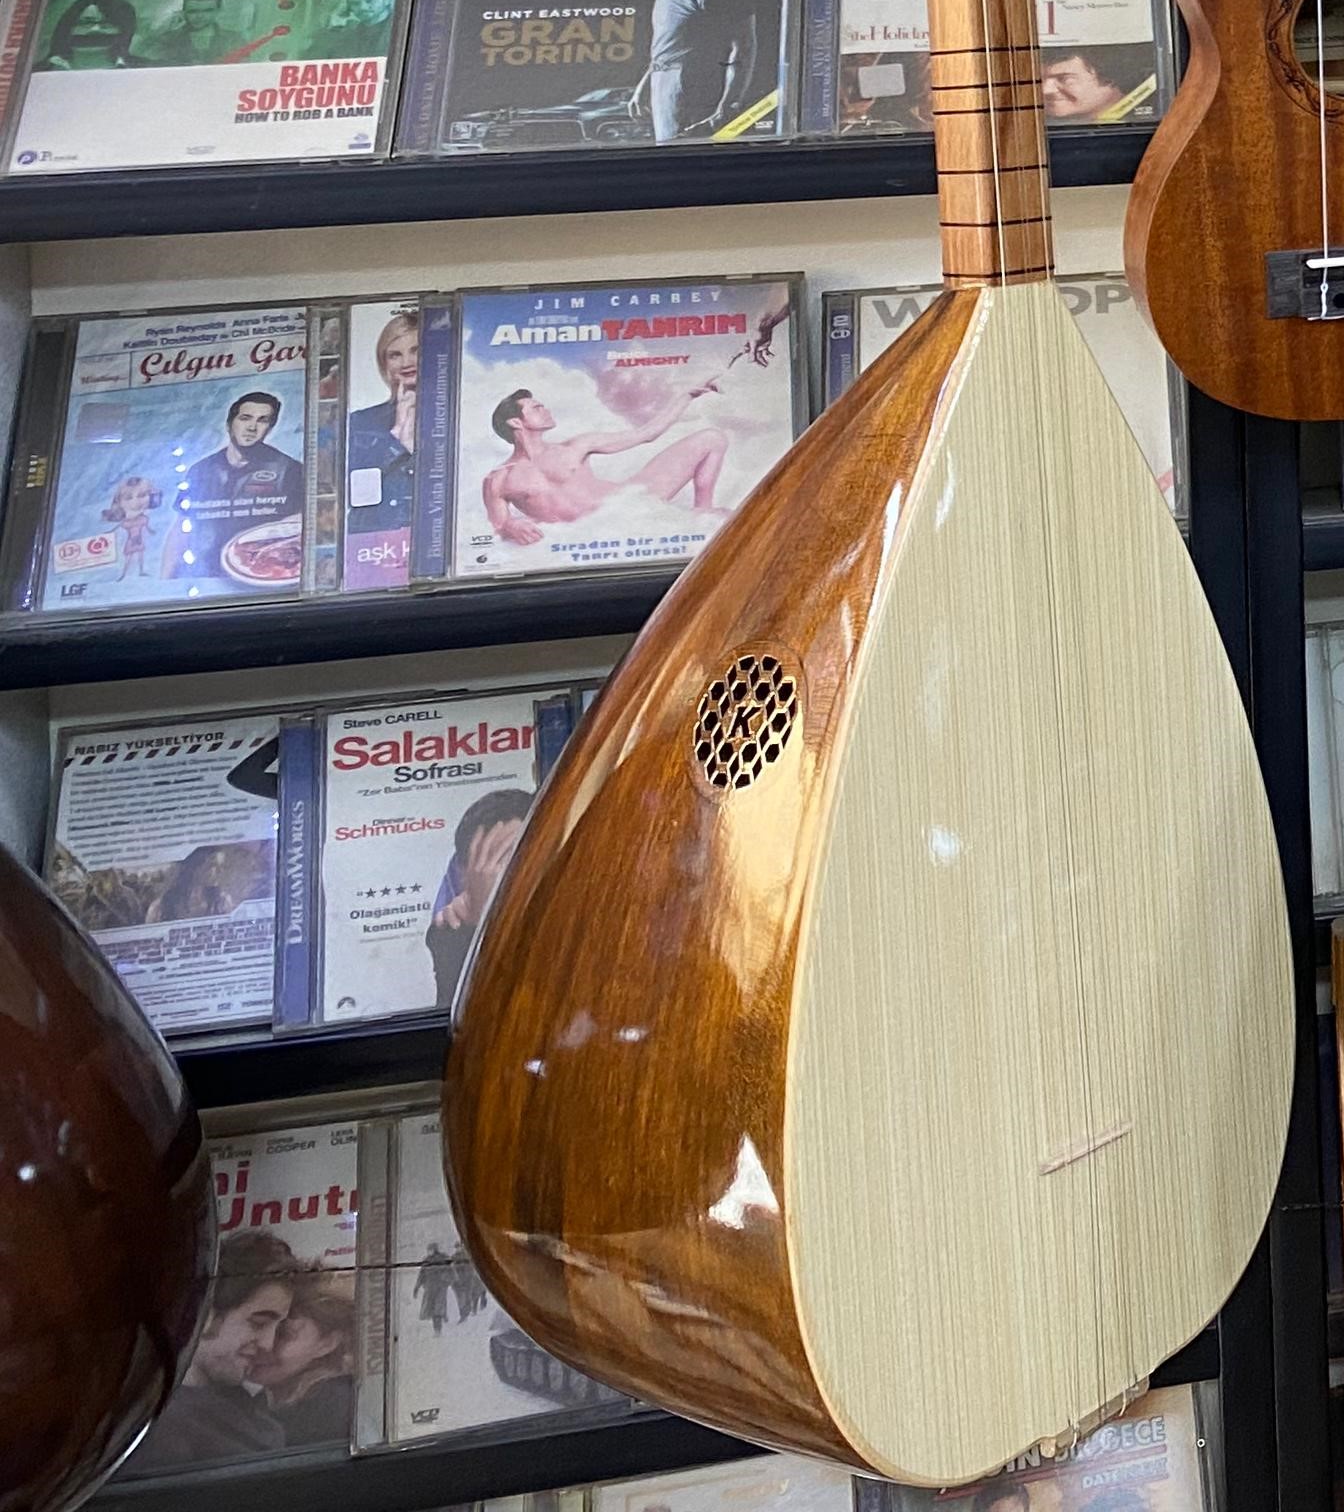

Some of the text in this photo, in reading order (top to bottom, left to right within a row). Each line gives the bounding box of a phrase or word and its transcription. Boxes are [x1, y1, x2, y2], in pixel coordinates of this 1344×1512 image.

[482, 6, 638, 21] CLINT EASTWOOD
[480, 16, 636, 49] GRAN
[480, 41, 636, 68] TORINO
[279, 60, 380, 88] BANKA
[236, 83, 378, 114] SOYGUNU
[234, 106, 375, 125] HOW TO ROB A BANK
[533, 289, 722, 310] JIM CARREY
[146, 326, 175, 338] Ryan
[175, 321, 227, 336] Reynolds
[232, 317, 260, 328] Anna
[489, 323, 602, 347] Aman
[601, 313, 748, 341] TANRIM
[139, 344, 236, 386] Çılgın
[615, 354, 691, 368] ALMIGHTY
[427, 353, 449, 558] Buena Vista Home Entertainment
[550, 532, 707, 553] Sıradan bir adam
[356, 542, 396, 567] aşk
[343, 710, 443, 730] Steve CARELL
[393, 761, 483, 784] Sofrası
[335, 817, 446, 841] Schmucks
[266, 1139, 316, 1155] COOPER
[409, 1406, 441, 1424] VCD
